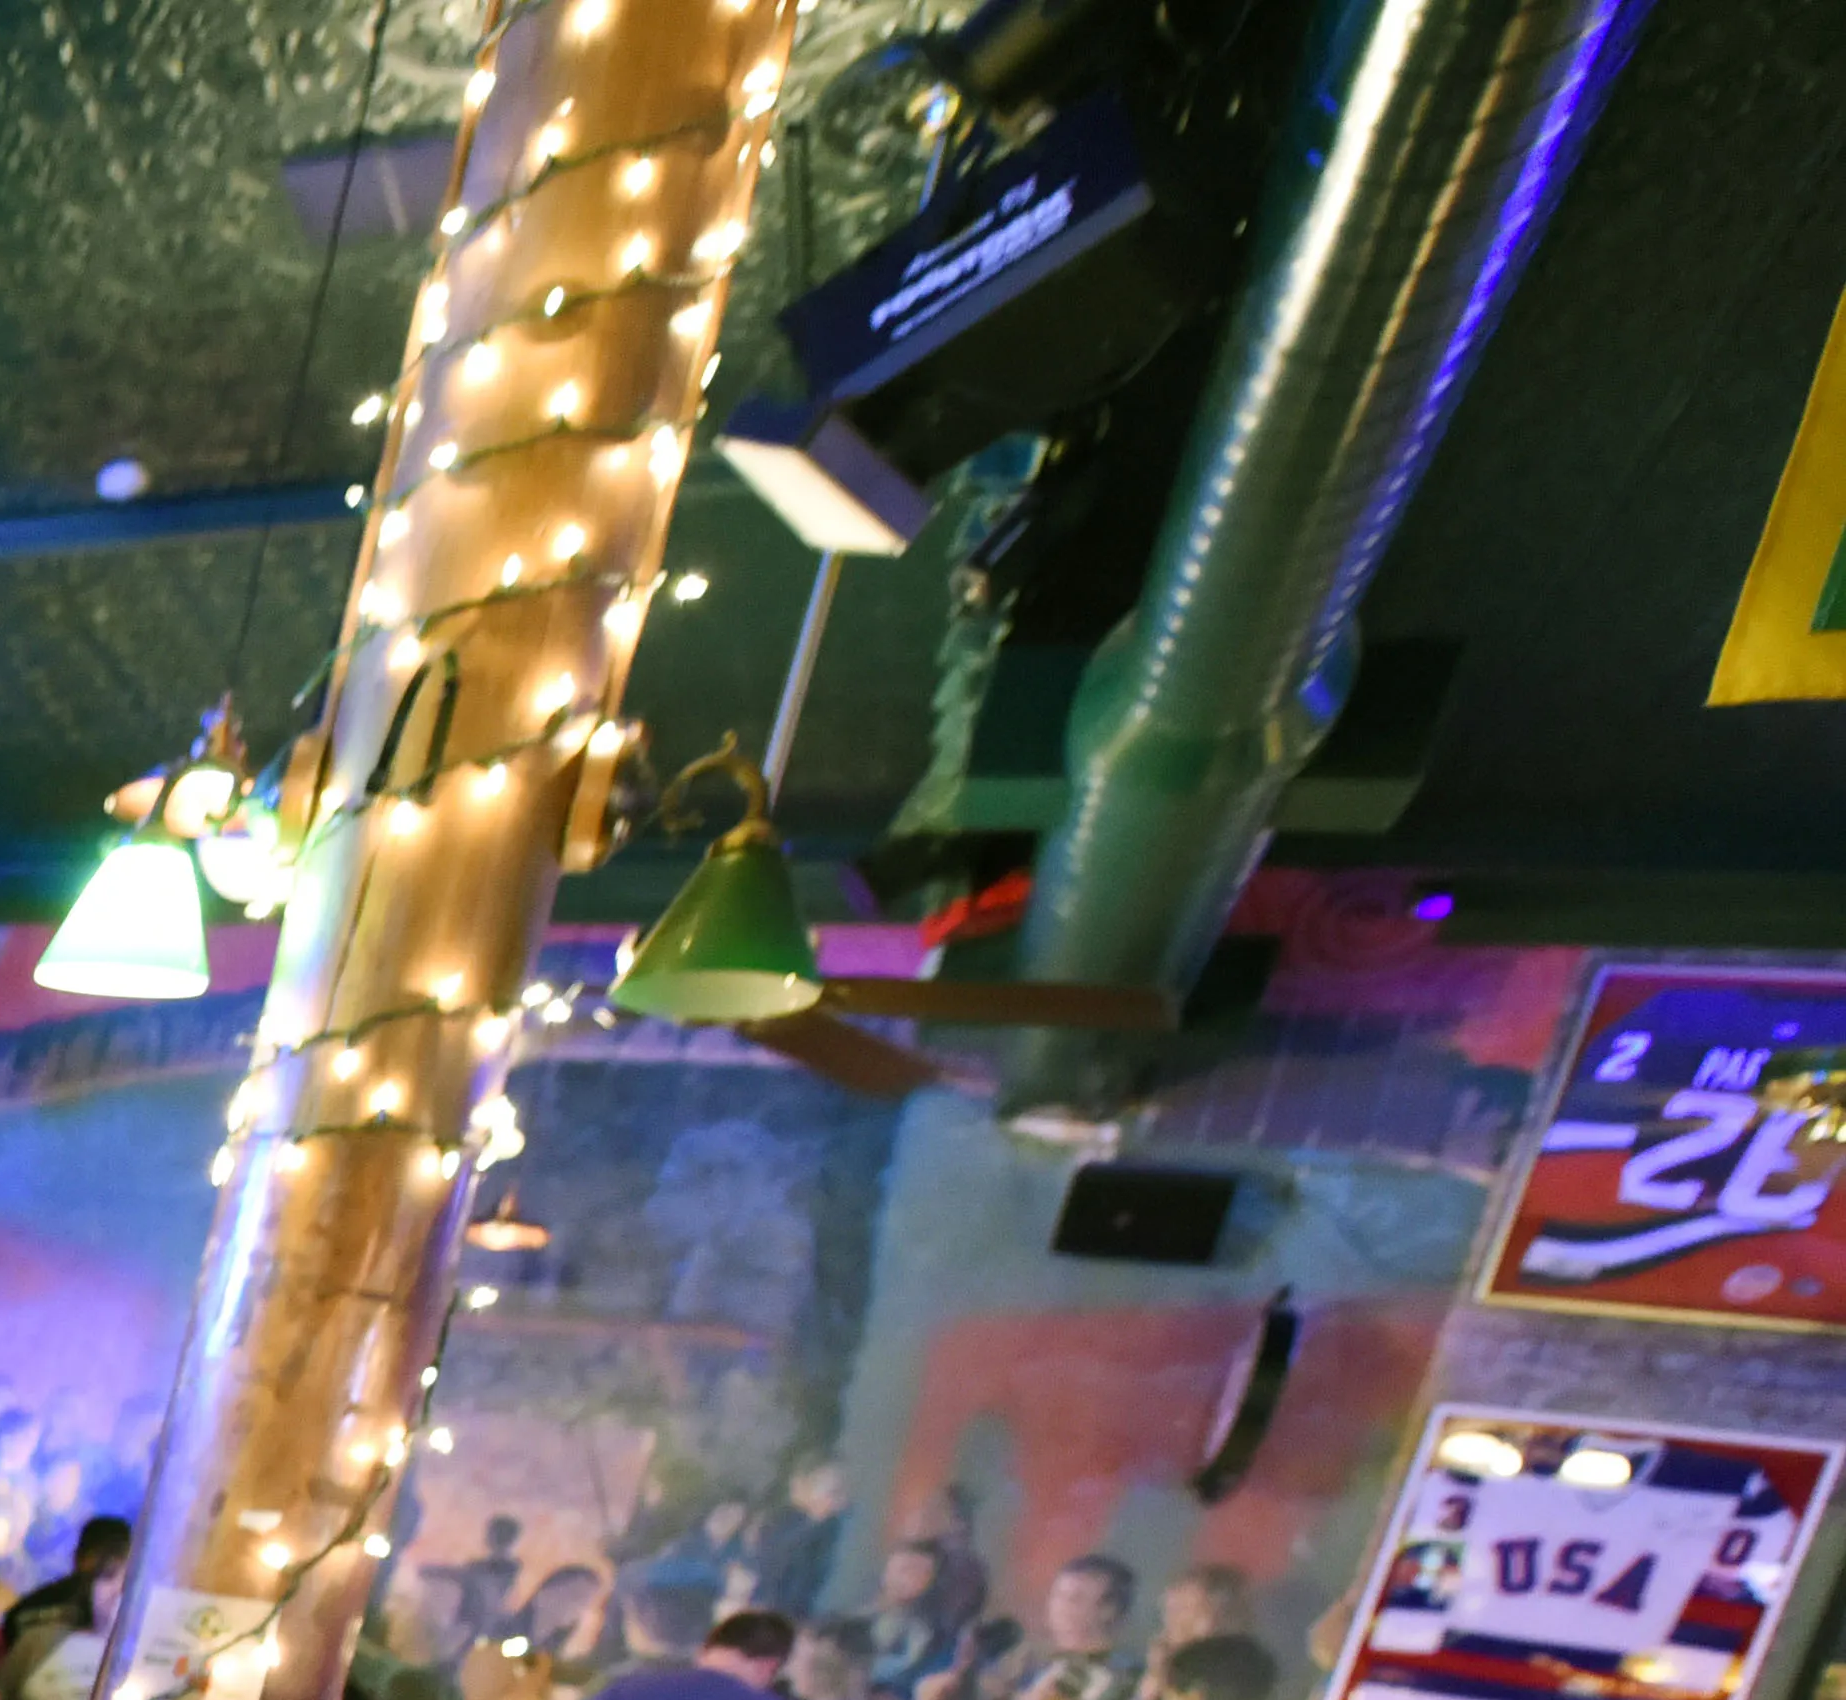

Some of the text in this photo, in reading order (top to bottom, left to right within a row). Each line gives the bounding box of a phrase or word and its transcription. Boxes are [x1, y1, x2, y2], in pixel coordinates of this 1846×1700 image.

[1594, 1030, 1653, 1083] 2
[1435, 1494, 1474, 1532] 3
[1712, 1528, 1760, 1568] 0
[1493, 1534, 1659, 1613] USA
